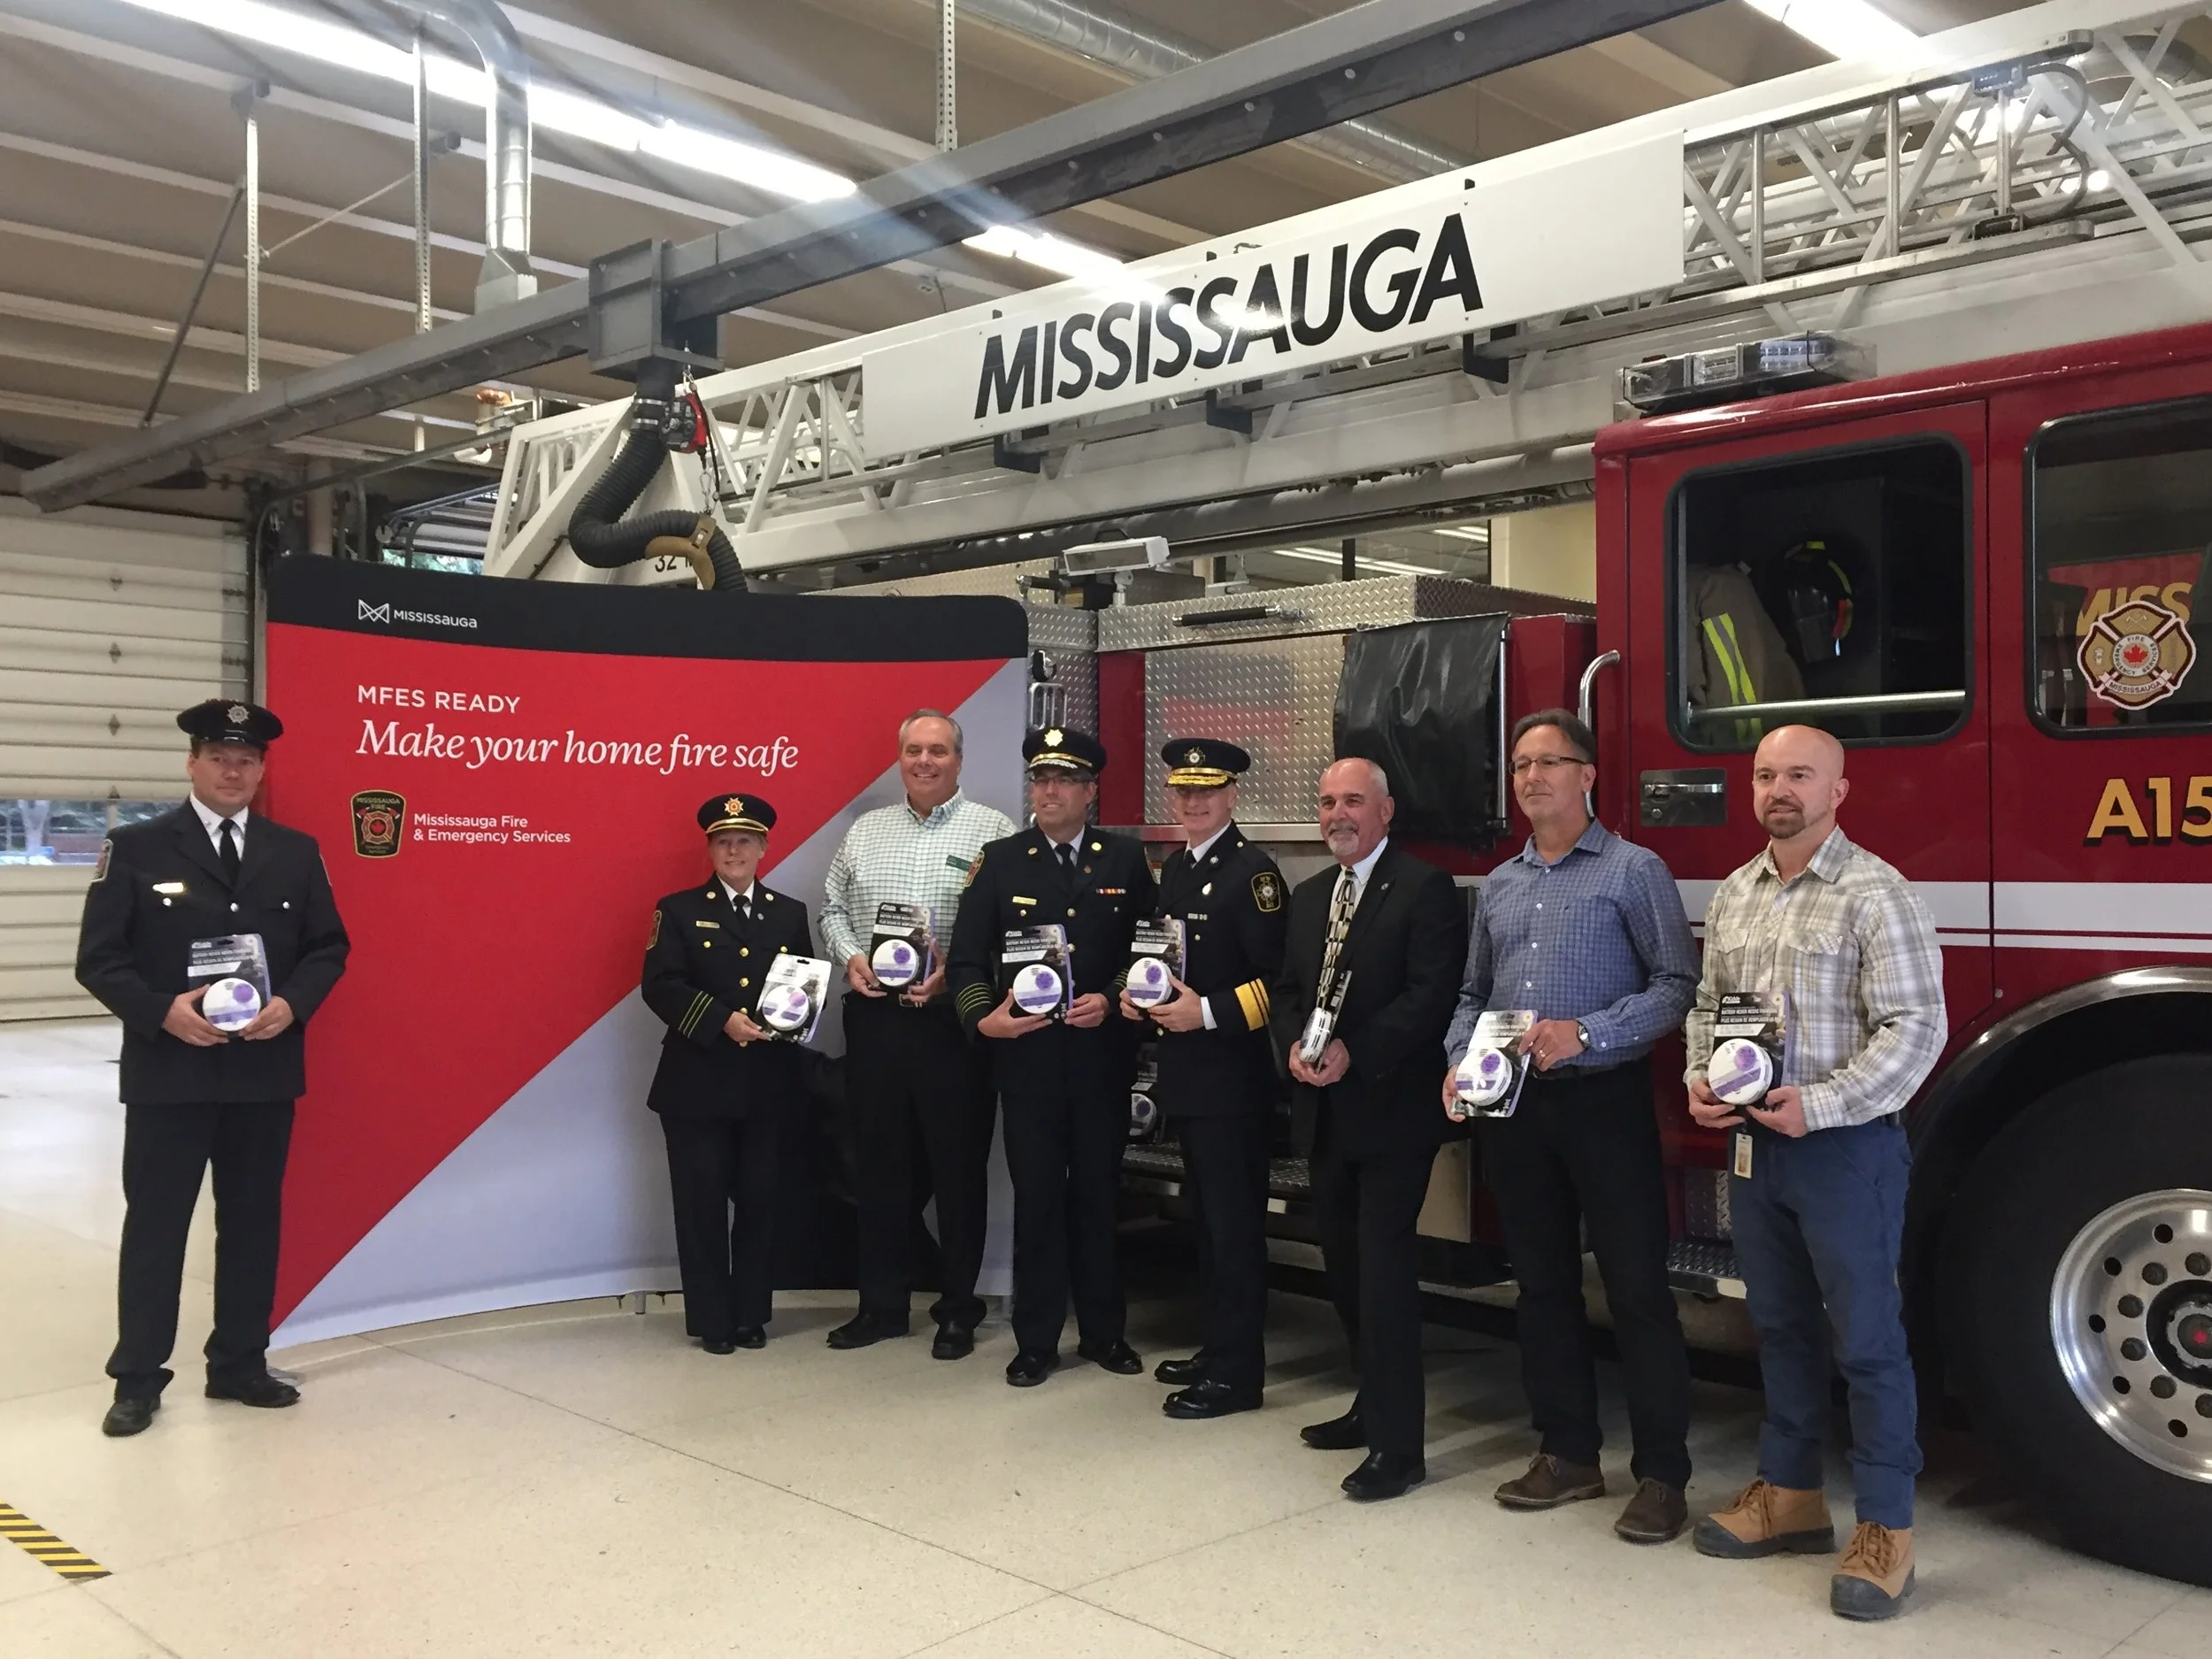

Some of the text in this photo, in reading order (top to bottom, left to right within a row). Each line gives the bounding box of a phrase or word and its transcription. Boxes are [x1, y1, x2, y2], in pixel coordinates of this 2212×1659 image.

[974, 213, 1483, 420] MISSISSAUGA
[655, 555, 677, 572] 32
[2108, 680, 2162, 694] MISSISSAUGA
[357, 684, 520, 714] MFES READY
[356, 719, 799, 777] Make your home fire safe
[413, 813, 528, 829] Mississauga Fire
[413, 828, 572, 844] & Emergency Services
